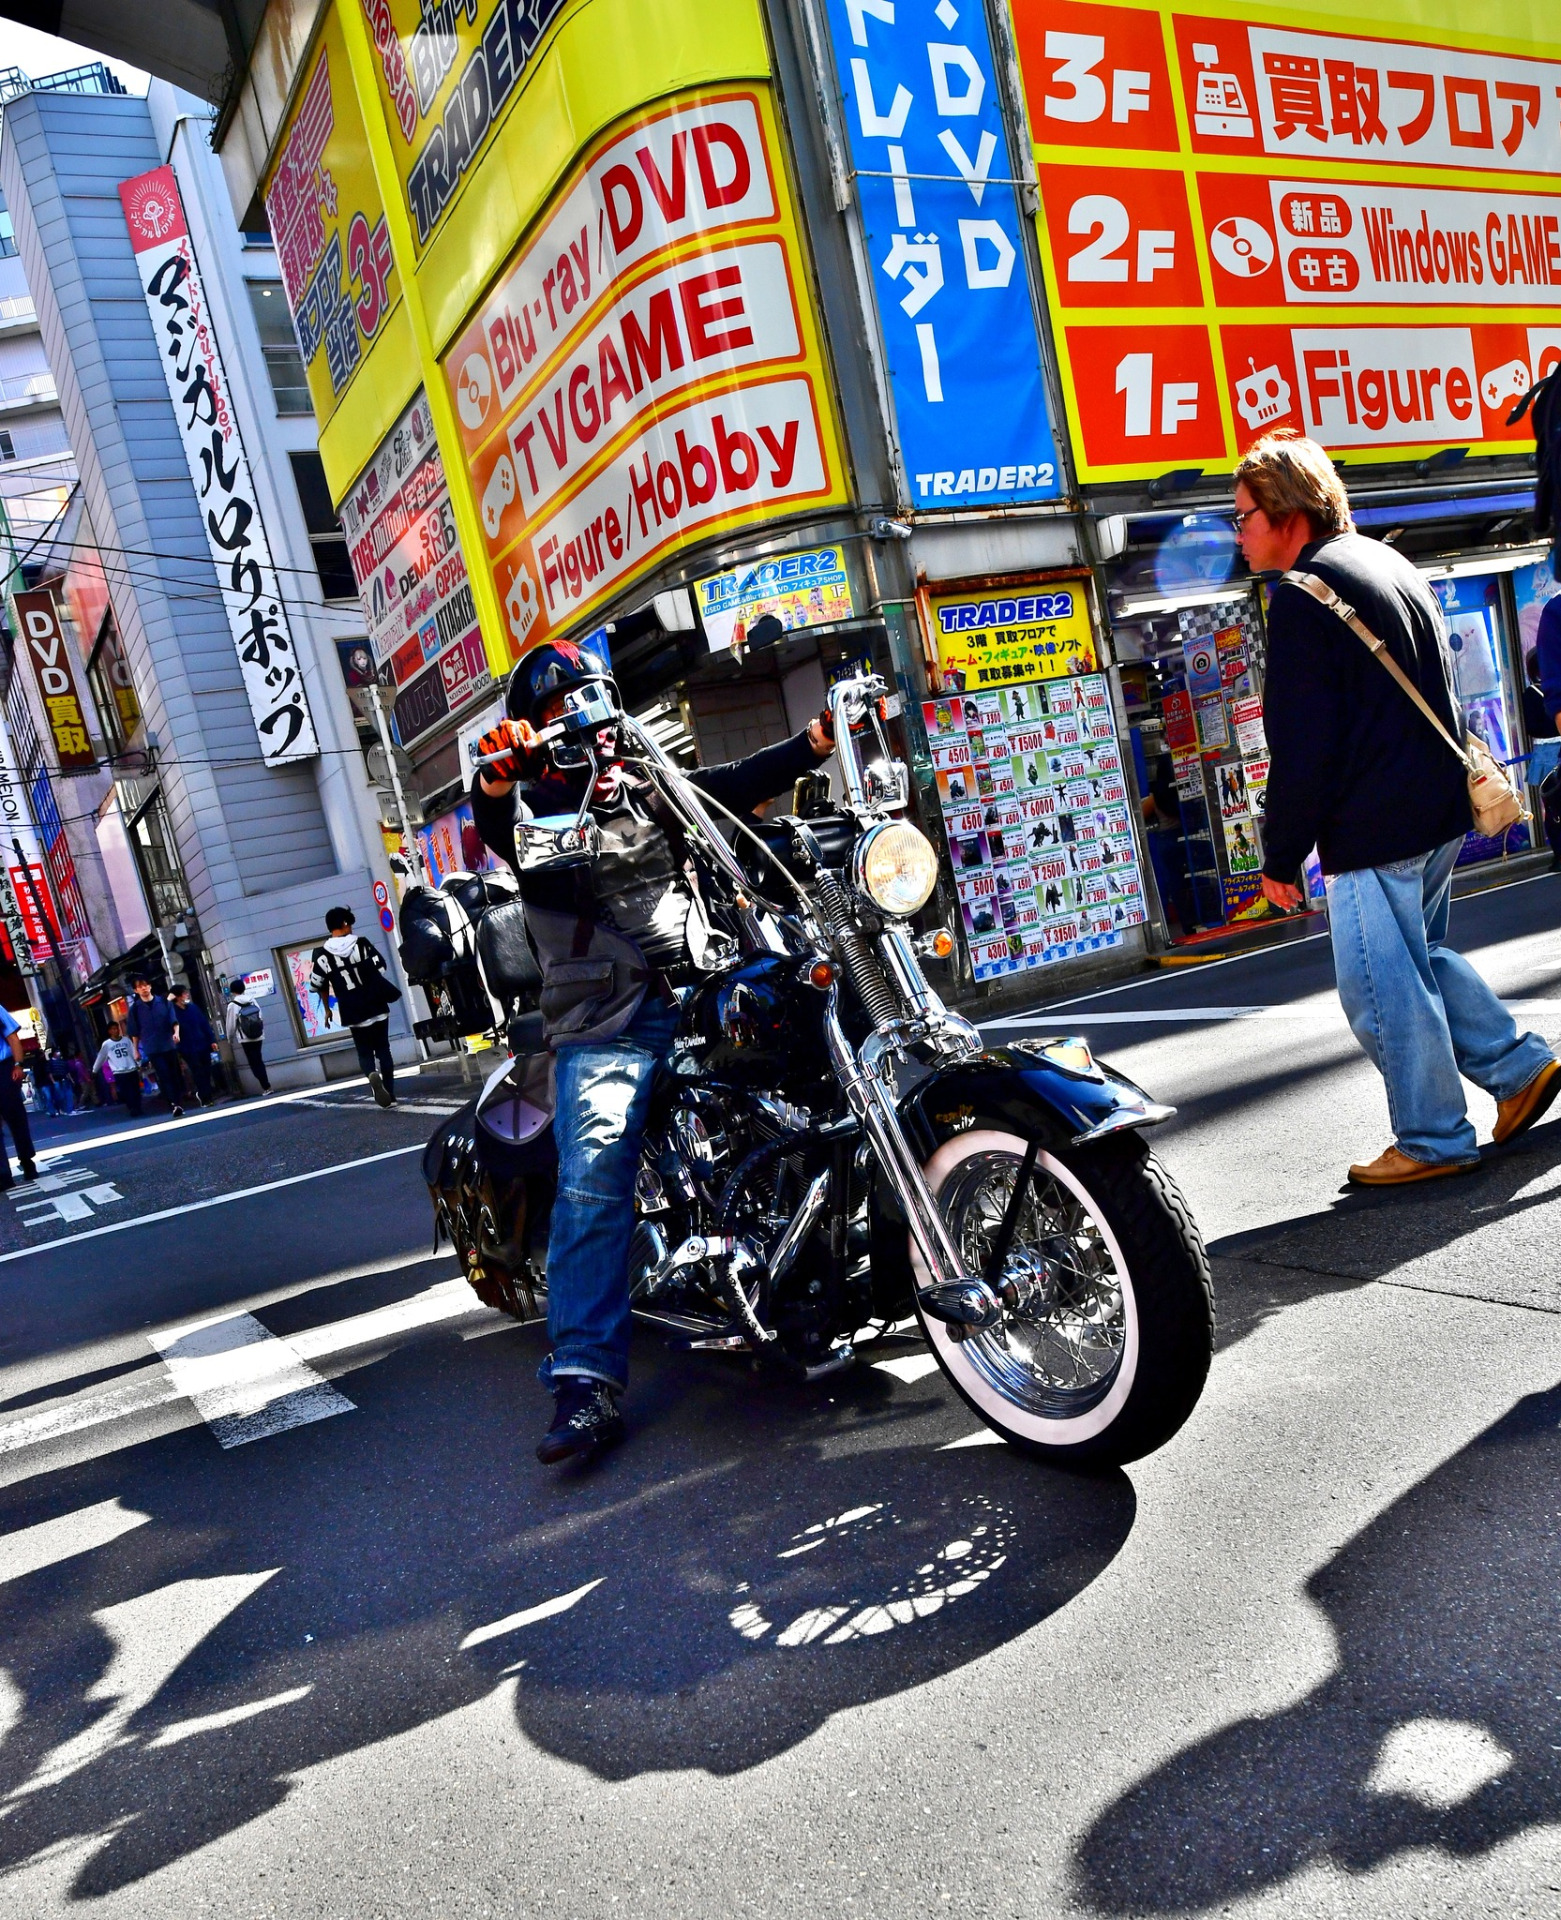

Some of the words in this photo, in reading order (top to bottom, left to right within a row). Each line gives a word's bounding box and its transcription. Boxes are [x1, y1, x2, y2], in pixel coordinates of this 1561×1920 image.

[1043, 30, 1152, 124] 3F
[1290, 199, 1341, 235] 新品
[1066, 194, 1176, 284] 2F
[1361, 206, 1483, 286] Windows
[1485, 211, 1561, 287] GAME
[1299, 253, 1347, 288] 中古
[513, 266, 754, 497] TVGAME
[1115, 352, 1199, 438] 1F
[1302, 348, 1473, 431] Figure
[915, 461, 1055, 497] TRADER2
[537, 414, 801, 612] Figure/Hobby
[701, 549, 837, 603] TRADER2
[939, 593, 1073, 632] TRADER2
[967, 634, 988, 649] 3階
[25, 610, 91, 757] DVD買取
[948, 746, 970, 764] 4500
[1018, 733, 1043, 752] 15000
[961, 812, 983, 831] 4500
[1030, 797, 1055, 817] 60000
[973, 877, 995, 897] 5000
[1041, 861, 1066, 880] 25000
[376, 886, 386, 900] 20
[987, 941, 1008, 960] 4300
[114, 1047, 129, 1059] 95
